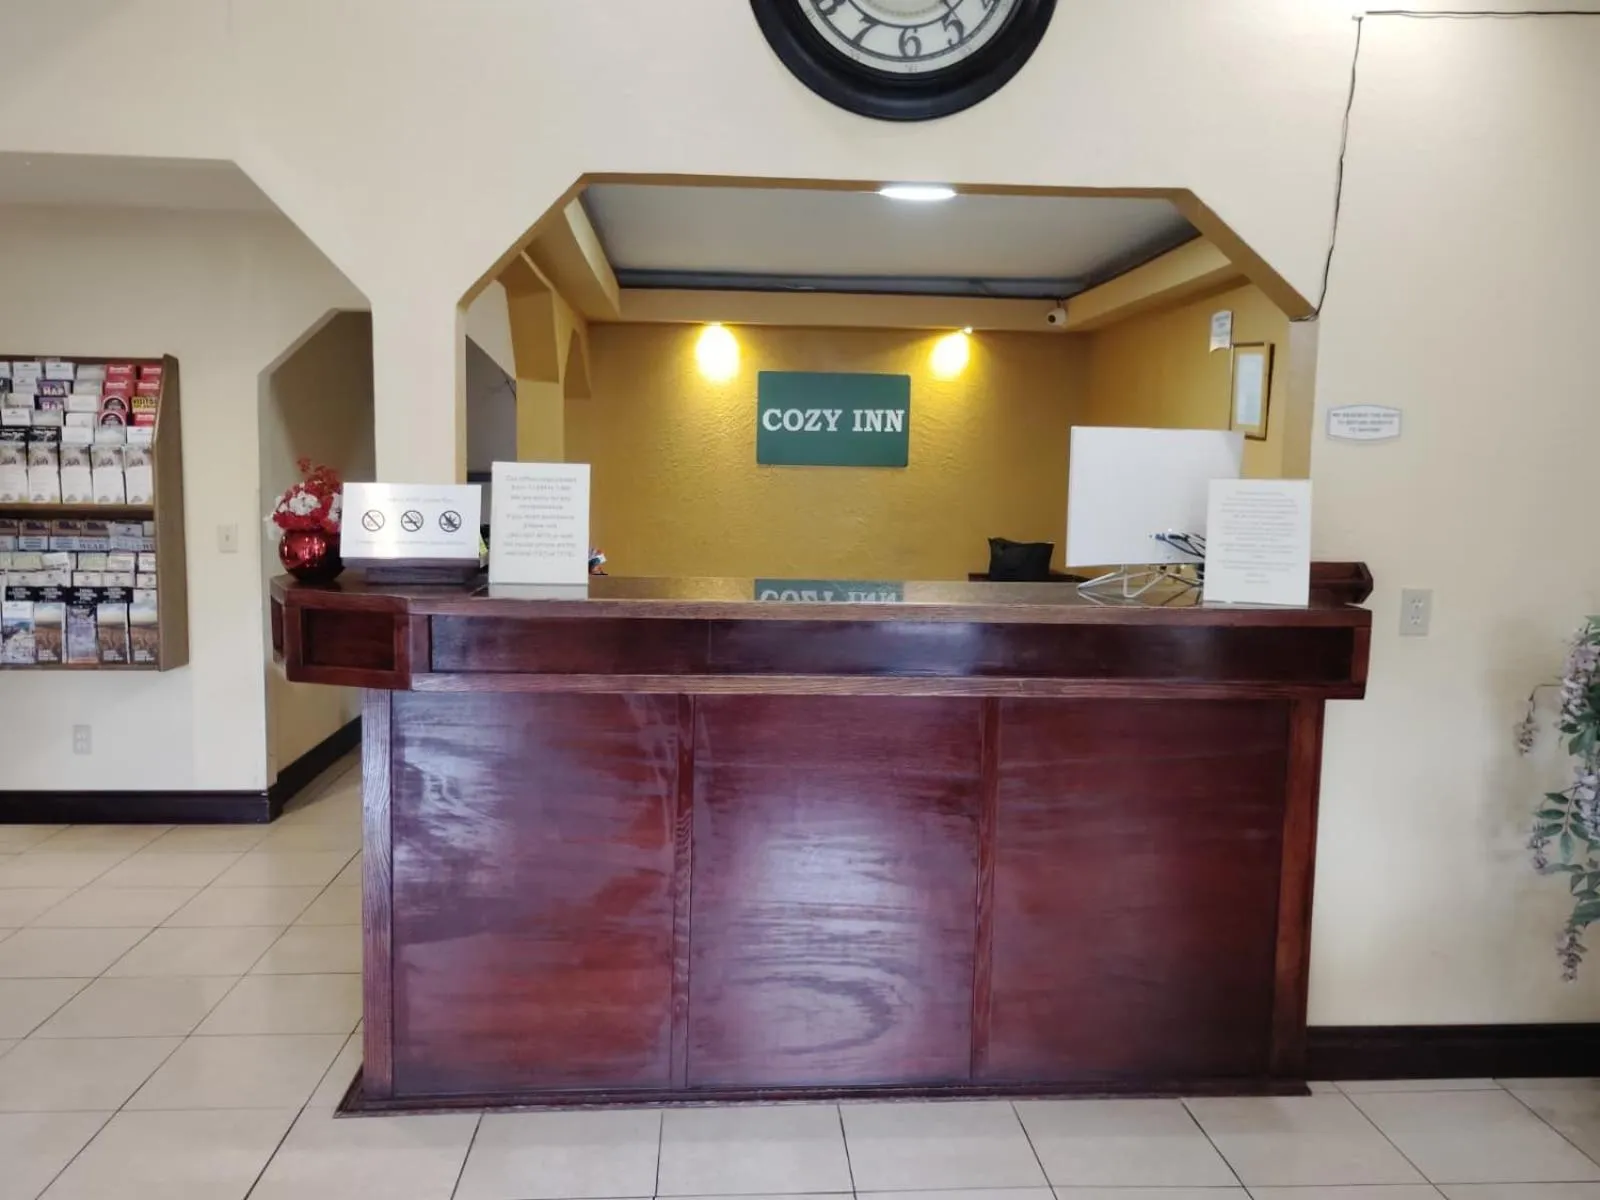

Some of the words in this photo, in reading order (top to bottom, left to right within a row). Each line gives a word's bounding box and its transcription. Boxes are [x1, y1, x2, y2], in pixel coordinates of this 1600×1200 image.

[852, 15, 880, 46] 7
[898, 27, 922, 57] 6
[941, 15, 965, 46] 5
[762, 408, 843, 432] COZY
[852, 409, 905, 432] INN
